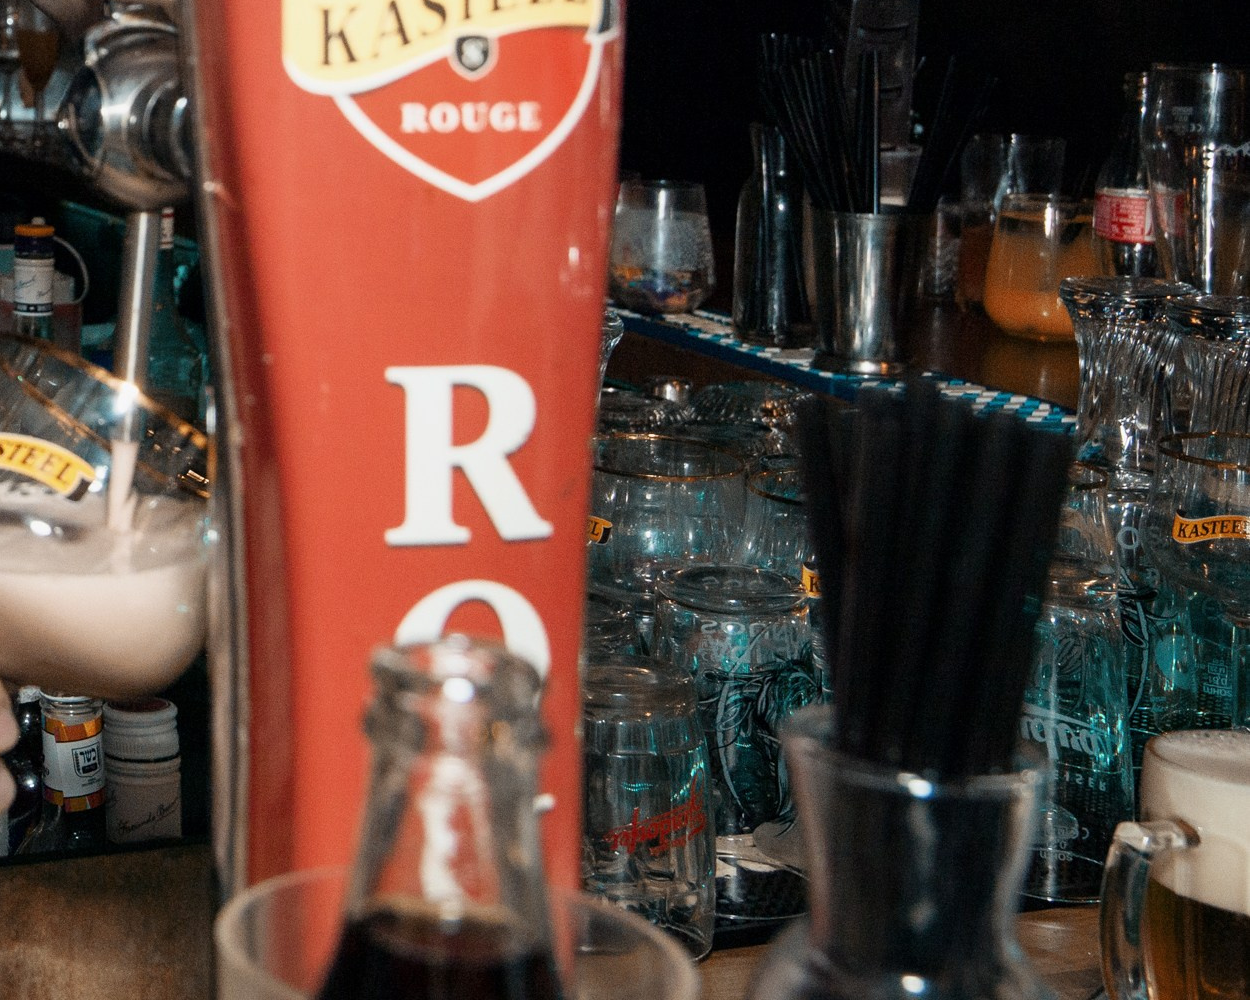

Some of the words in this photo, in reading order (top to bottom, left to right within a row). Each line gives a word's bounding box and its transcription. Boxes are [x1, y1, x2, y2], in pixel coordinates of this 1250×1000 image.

[399, 100, 542, 134] ROUGE
[1177, 519, 1248, 539] KASTEE
[79, 748, 96, 764] כשר
